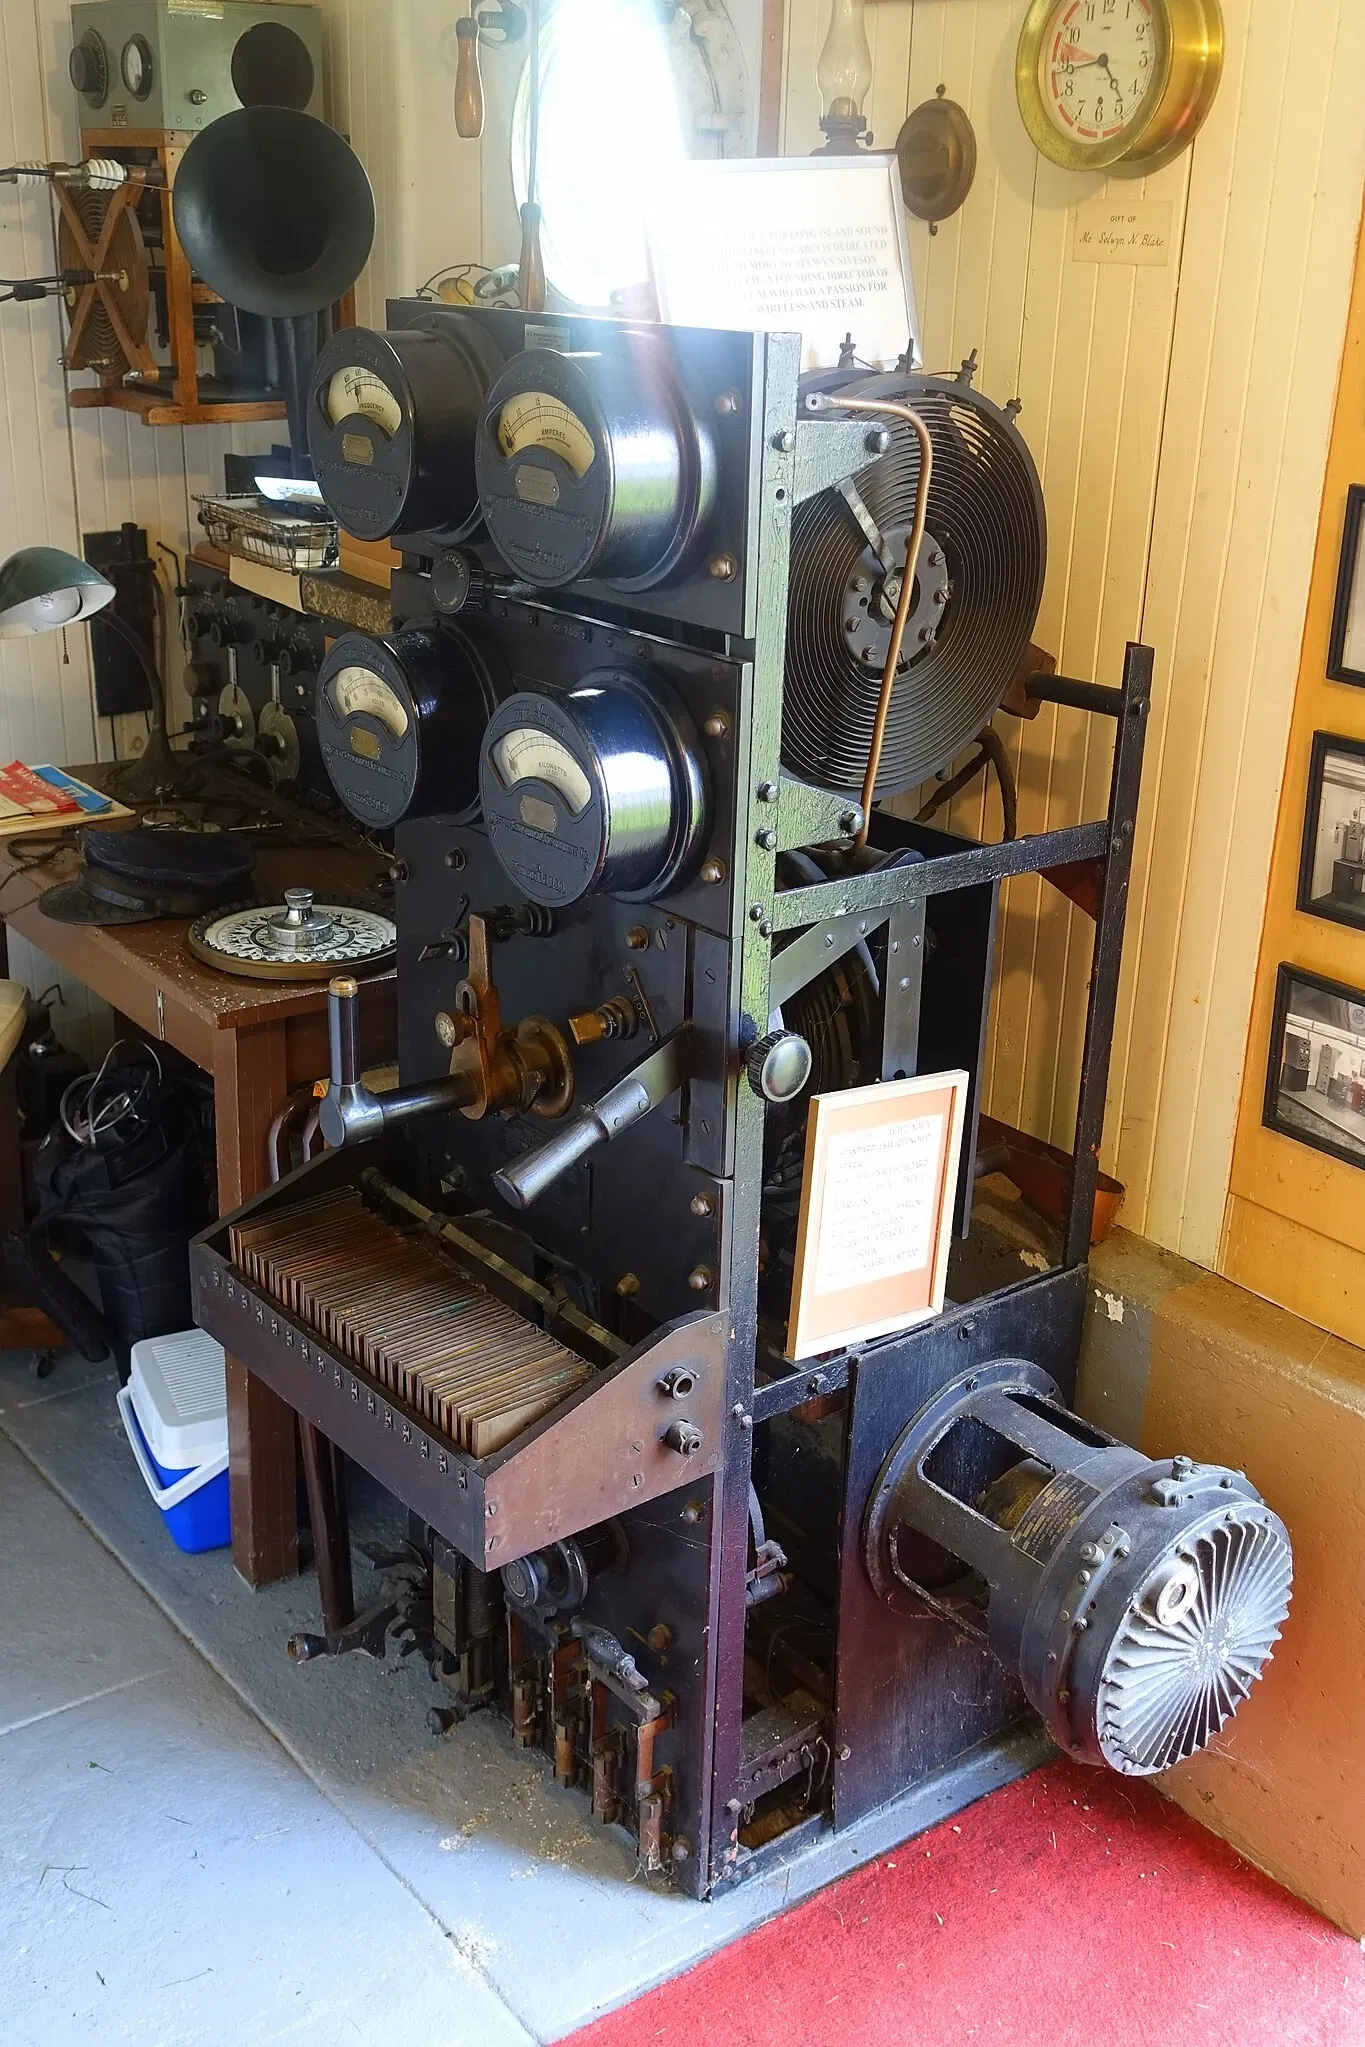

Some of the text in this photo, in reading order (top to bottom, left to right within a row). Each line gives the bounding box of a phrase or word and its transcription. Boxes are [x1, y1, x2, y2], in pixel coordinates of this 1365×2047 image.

[1086, 4, 1095, 21] 11
[1126, 1, 1130, 19] 1
[1069, 27, 1081, 44] 10
[1135, 23, 1145, 42] 2
[1138, 50, 1149, 68] 3
[1064, 80, 1074, 97] 8
[1128, 77, 1138, 96] 4
[1078, 99, 1087, 116] 7
[1094, 105, 1104, 123] 6
[1114, 99, 1123, 116] 5
[1110, 215, 1125, 223] GIFT
[819, 227, 853, 238] ISLAND
[855, 225, 888, 236] SOUND
[1140, 233, 1165, 247] Blake
[827, 268, 877, 281] DIRECTOR
[877, 267, 889, 277] OF
[795, 287, 816, 297] HAD
[827, 282, 866, 295] PASSION
[868, 281, 888, 292] FOR
[809, 300, 829, 311] AND
[830, 297, 865, 309] STEAM.
[541, 428, 566, 440] AMPERES
